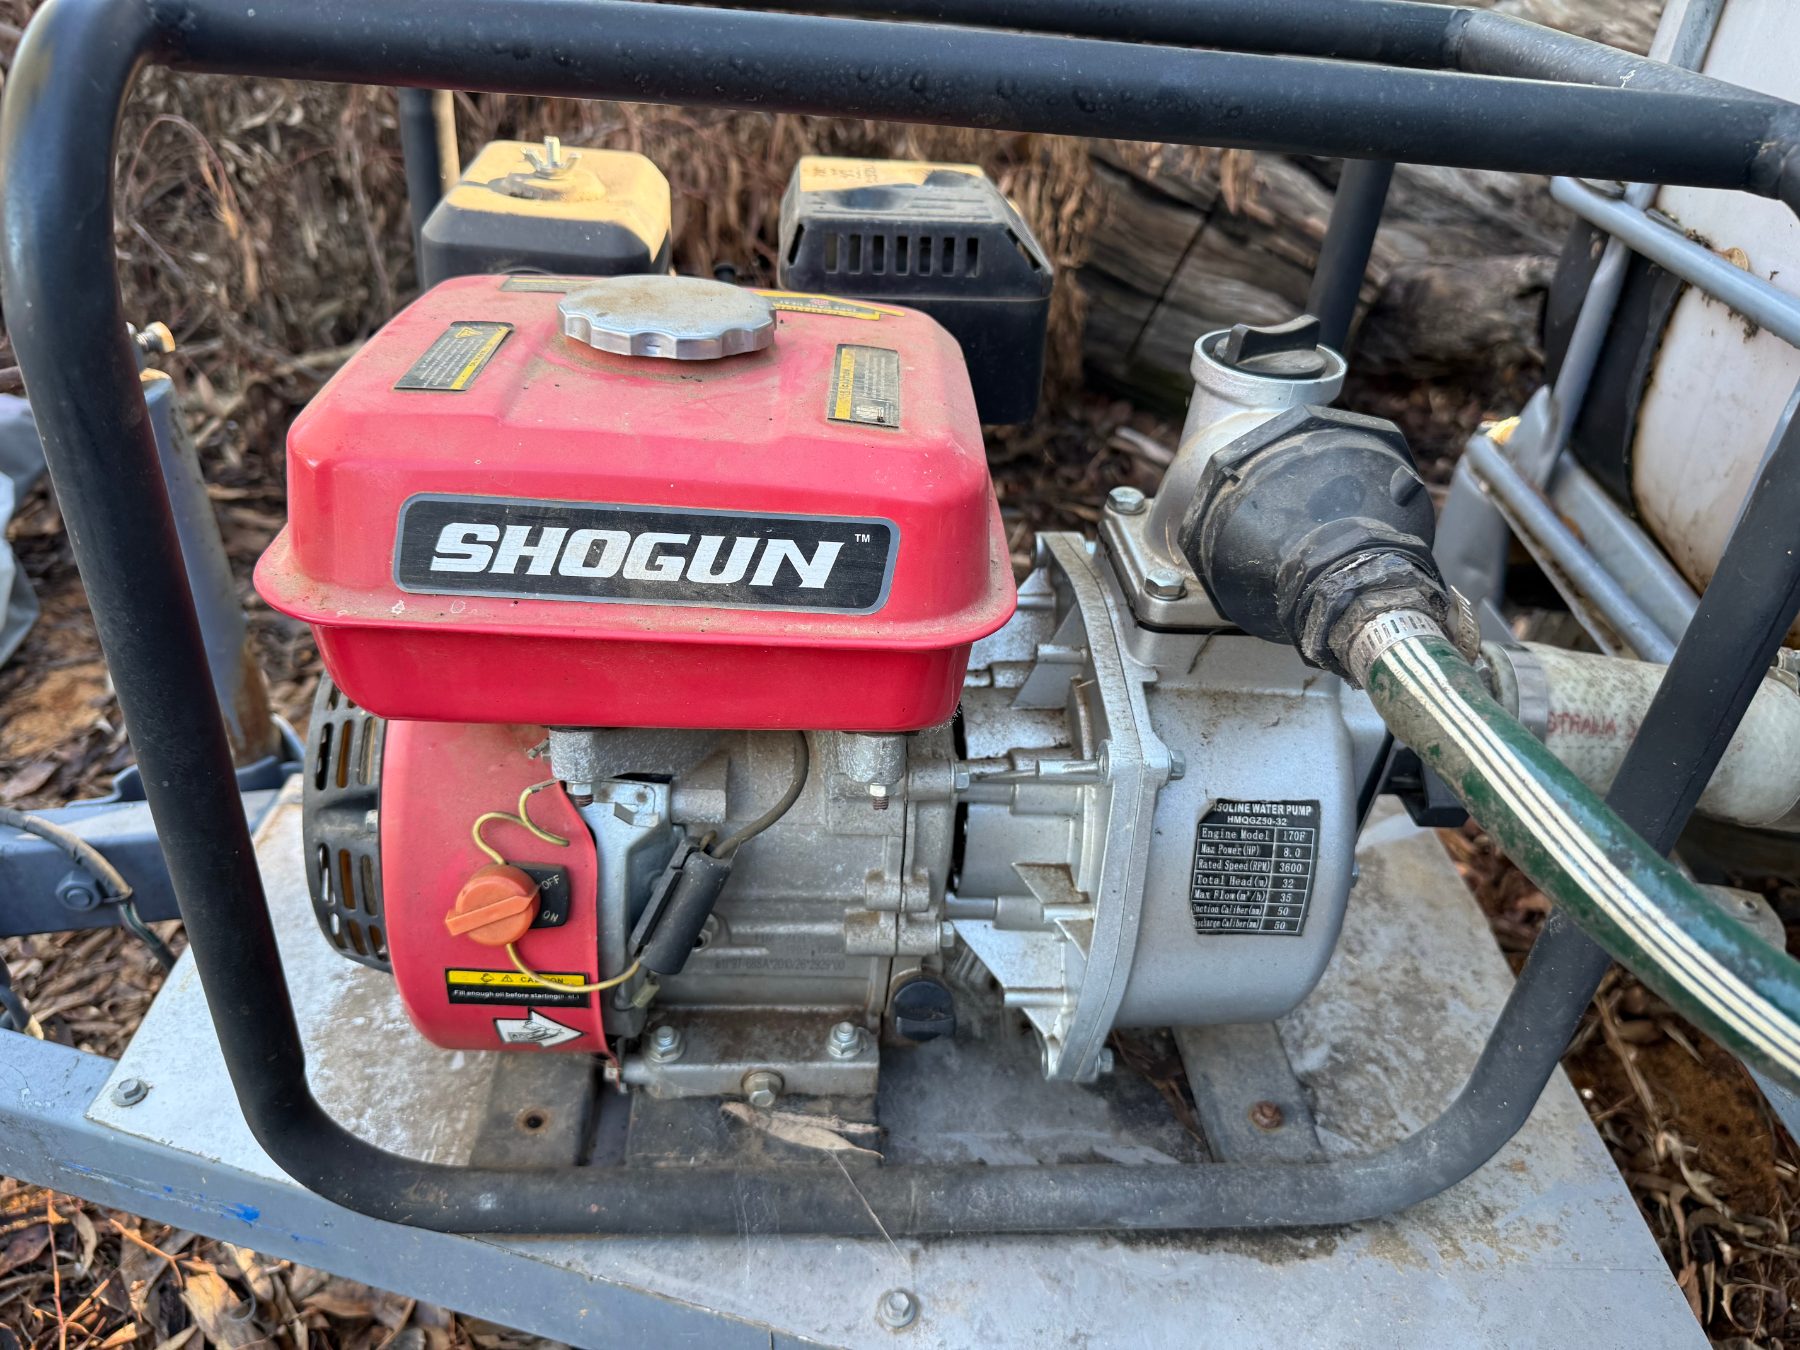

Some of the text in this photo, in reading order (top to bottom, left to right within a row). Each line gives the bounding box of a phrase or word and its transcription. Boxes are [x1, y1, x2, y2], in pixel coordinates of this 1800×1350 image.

[430, 522, 845, 589] SHOGUN
[1252, 803, 1284, 814] WATER
[1286, 804, 1312, 816] PUMP
[1227, 816, 1287, 826] HMQGZ50-32
[1202, 828, 1306, 841] Engine Model 170F
[1201, 843, 1215, 853] Max
[1218, 844, 1260, 856] Power(HP)
[1198, 859, 1302, 873] Rated Speed(RPM) 3600
[541, 874, 560, 889] OFF
[1197, 875, 1224, 885] Total
[1282, 878, 1294, 888] 32
[1194, 889, 1210, 899] Max
[1280, 893, 1292, 902] 35
[543, 910, 559, 922] ON
[1277, 906, 1289, 916] 50
[1274, 921, 1286, 930] 50
[454, 989, 466, 997] Fill
[466, 991, 494, 999] enough
